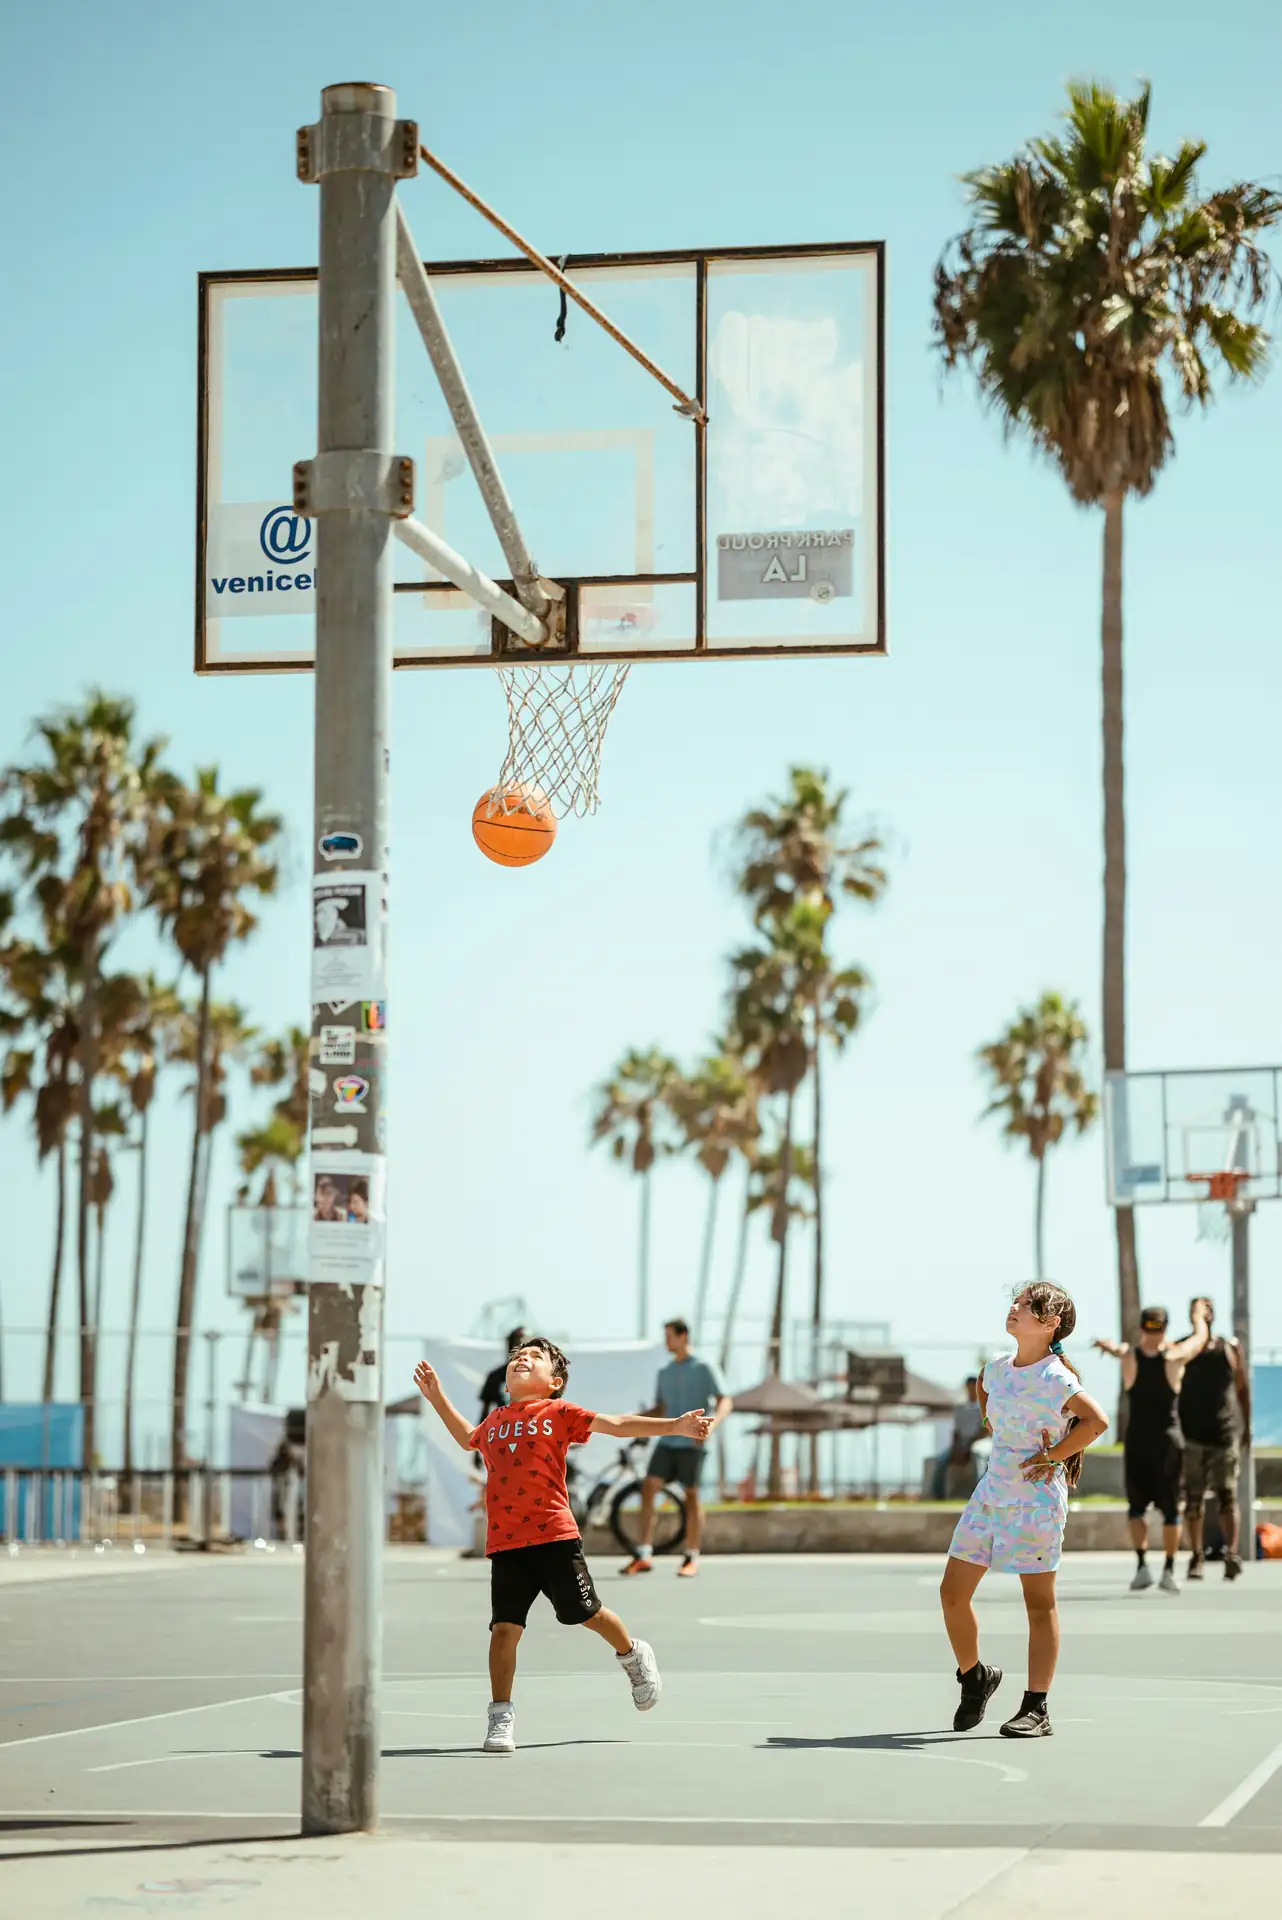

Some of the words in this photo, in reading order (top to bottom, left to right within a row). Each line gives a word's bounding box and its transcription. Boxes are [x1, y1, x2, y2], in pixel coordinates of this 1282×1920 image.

[211, 568, 317, 594] venice
[487, 1419, 553, 1443] GUESS
[576, 1573, 592, 1607] GUESS
